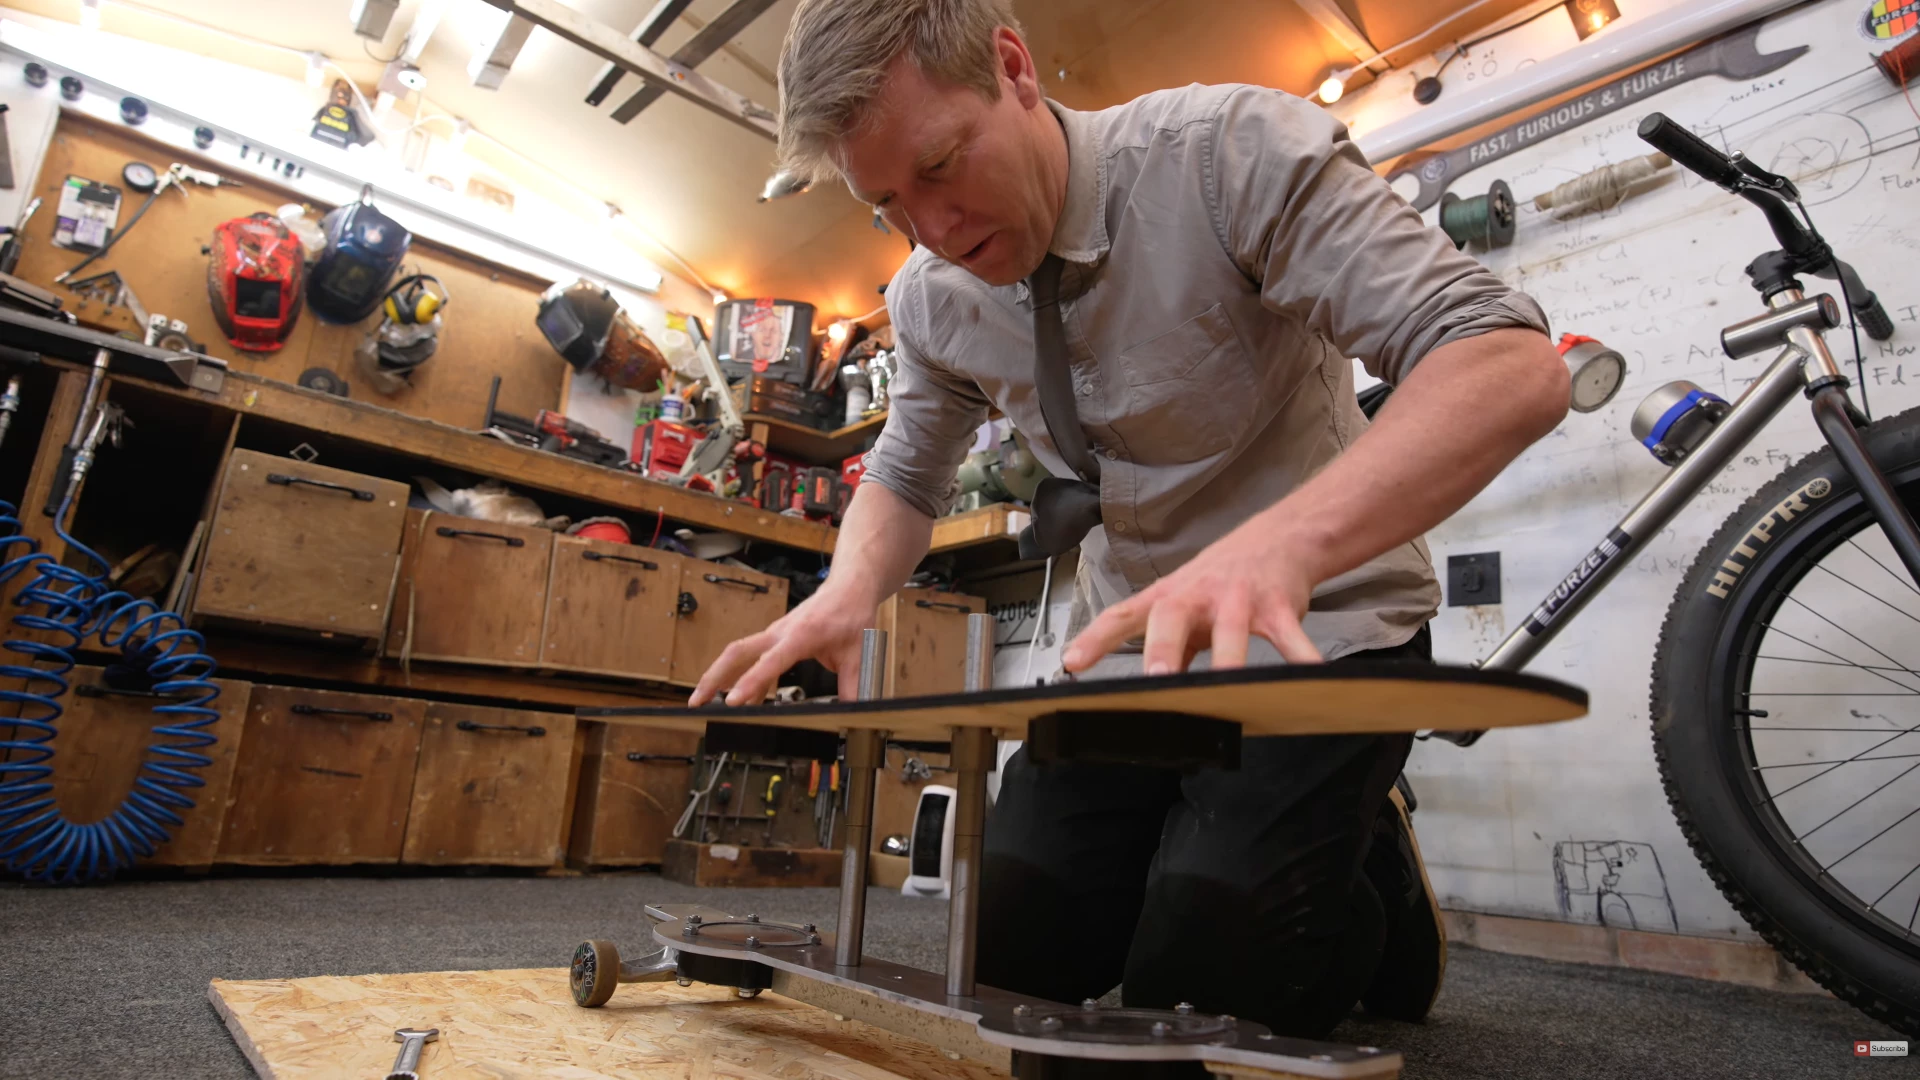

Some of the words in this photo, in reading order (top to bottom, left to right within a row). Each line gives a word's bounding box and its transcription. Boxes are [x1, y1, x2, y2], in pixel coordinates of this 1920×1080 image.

[1469, 134, 1512, 163] FAST,
[1516, 99, 1596, 144] FURIOUS
[1600, 90, 1615, 108] &
[1621, 57, 1687, 98] FURZE
[1545, 552, 1602, 610] FURZE
[1706, 477, 1831, 600] HITPRO
